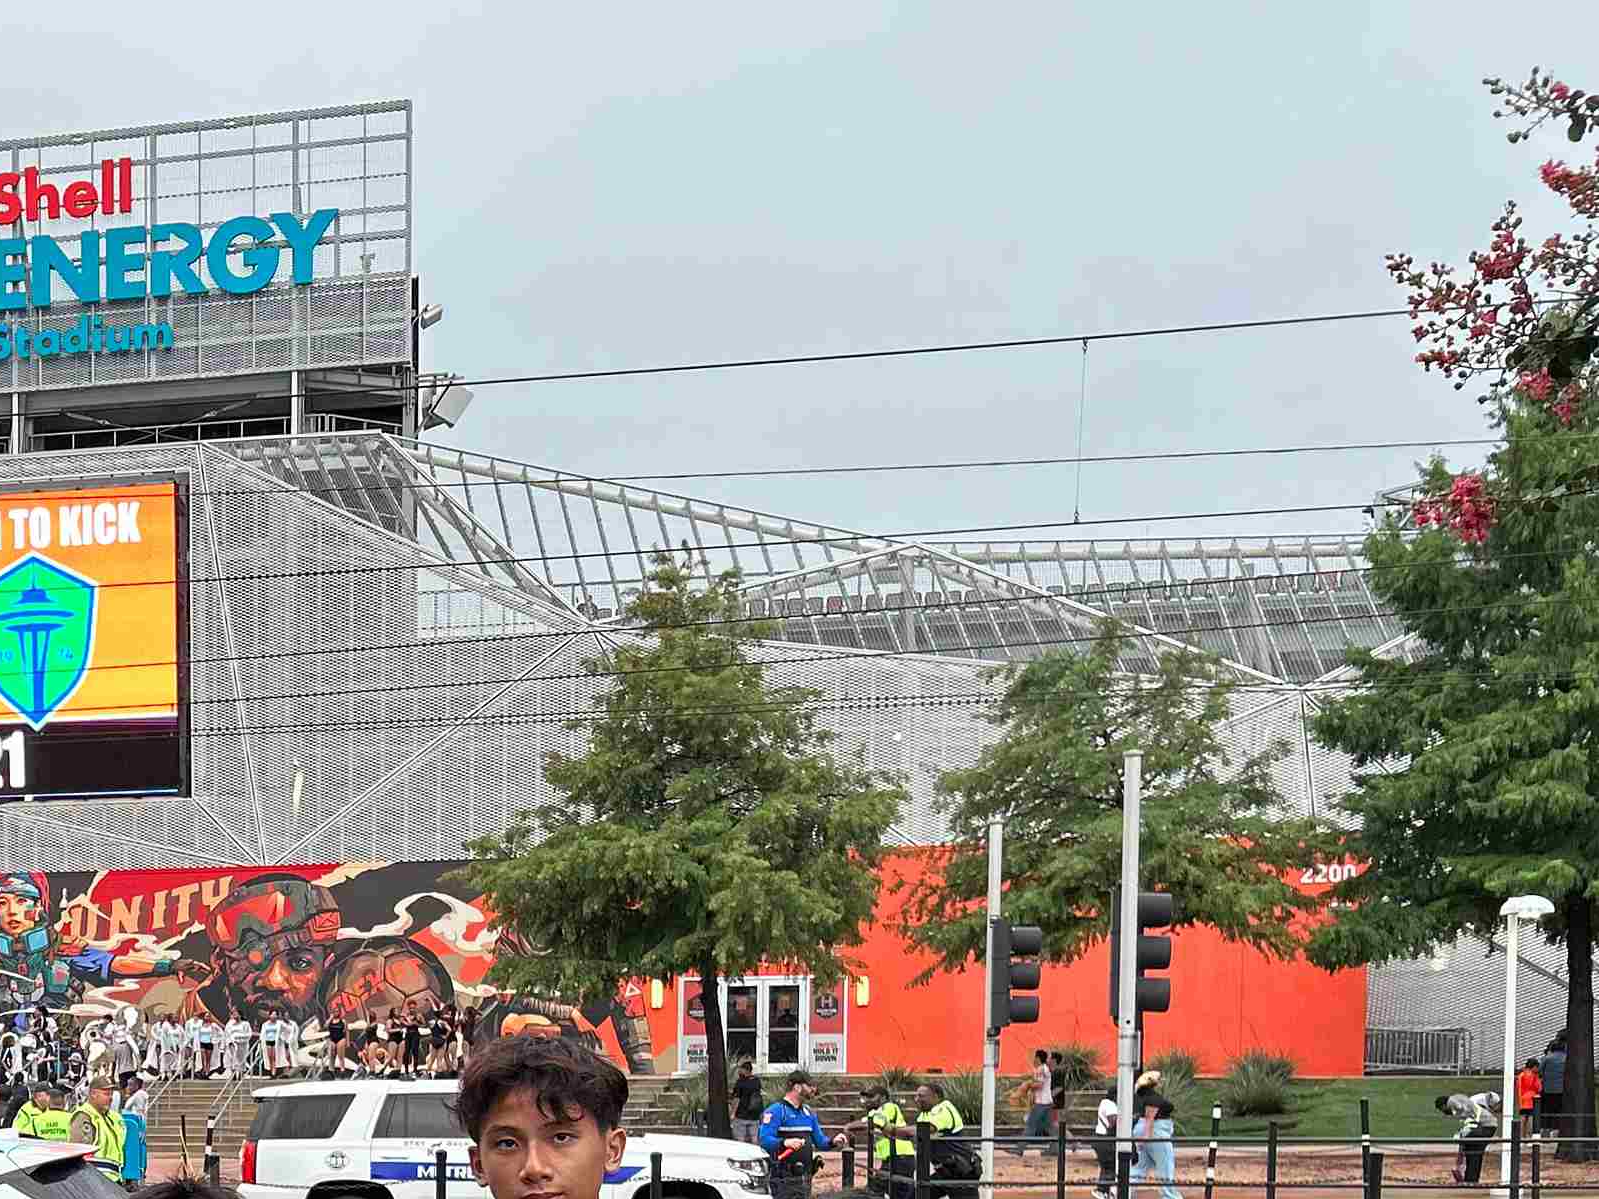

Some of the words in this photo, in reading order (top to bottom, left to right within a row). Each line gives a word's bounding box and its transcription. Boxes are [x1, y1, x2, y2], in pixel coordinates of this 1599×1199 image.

[8, 508, 50, 549] TO
[59, 501, 142, 547] KICK
[417, 1165, 473, 1179] MTR
